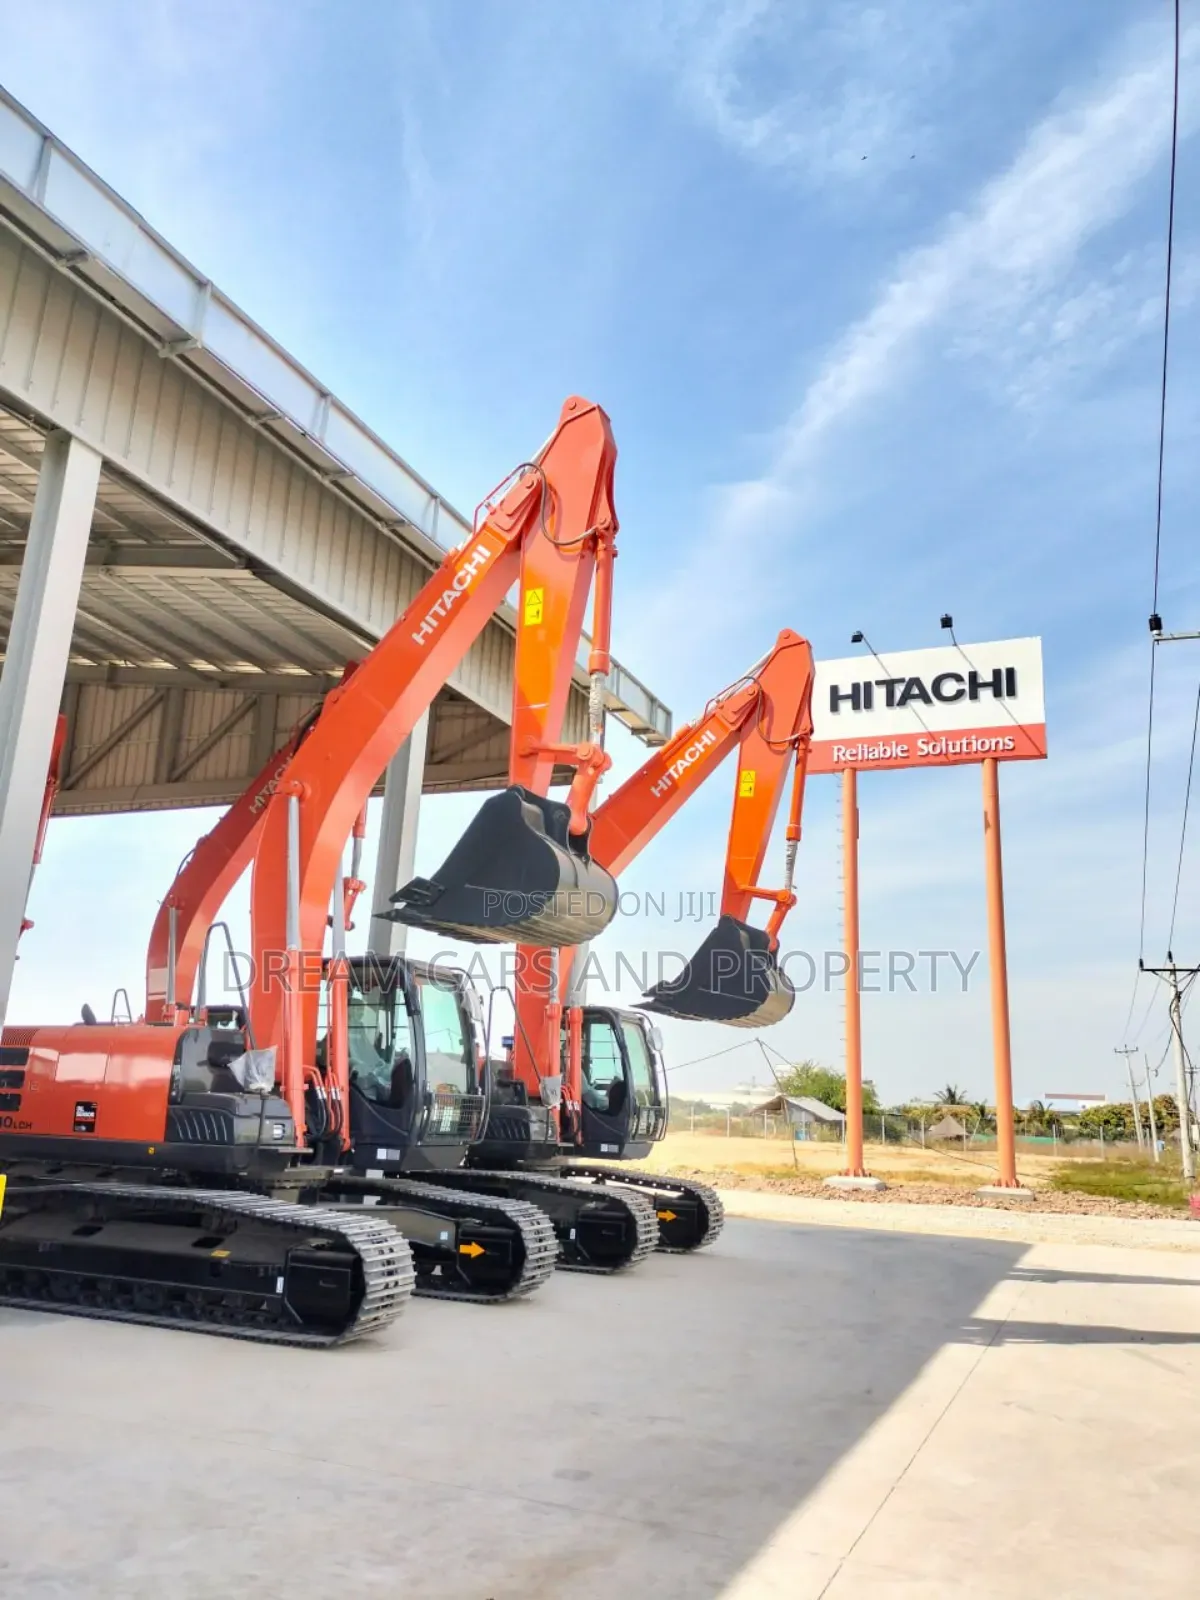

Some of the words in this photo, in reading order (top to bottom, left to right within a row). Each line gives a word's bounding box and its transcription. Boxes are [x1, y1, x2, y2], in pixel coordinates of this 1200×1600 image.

[412, 544, 491, 646] HITACHI
[829, 667, 1016, 713] HITACHI
[650, 730, 716, 798] HITACHI
[832, 740, 910, 763] Reliable
[916, 734, 1016, 757] Solutions
[249, 752, 294, 814] HITAC
